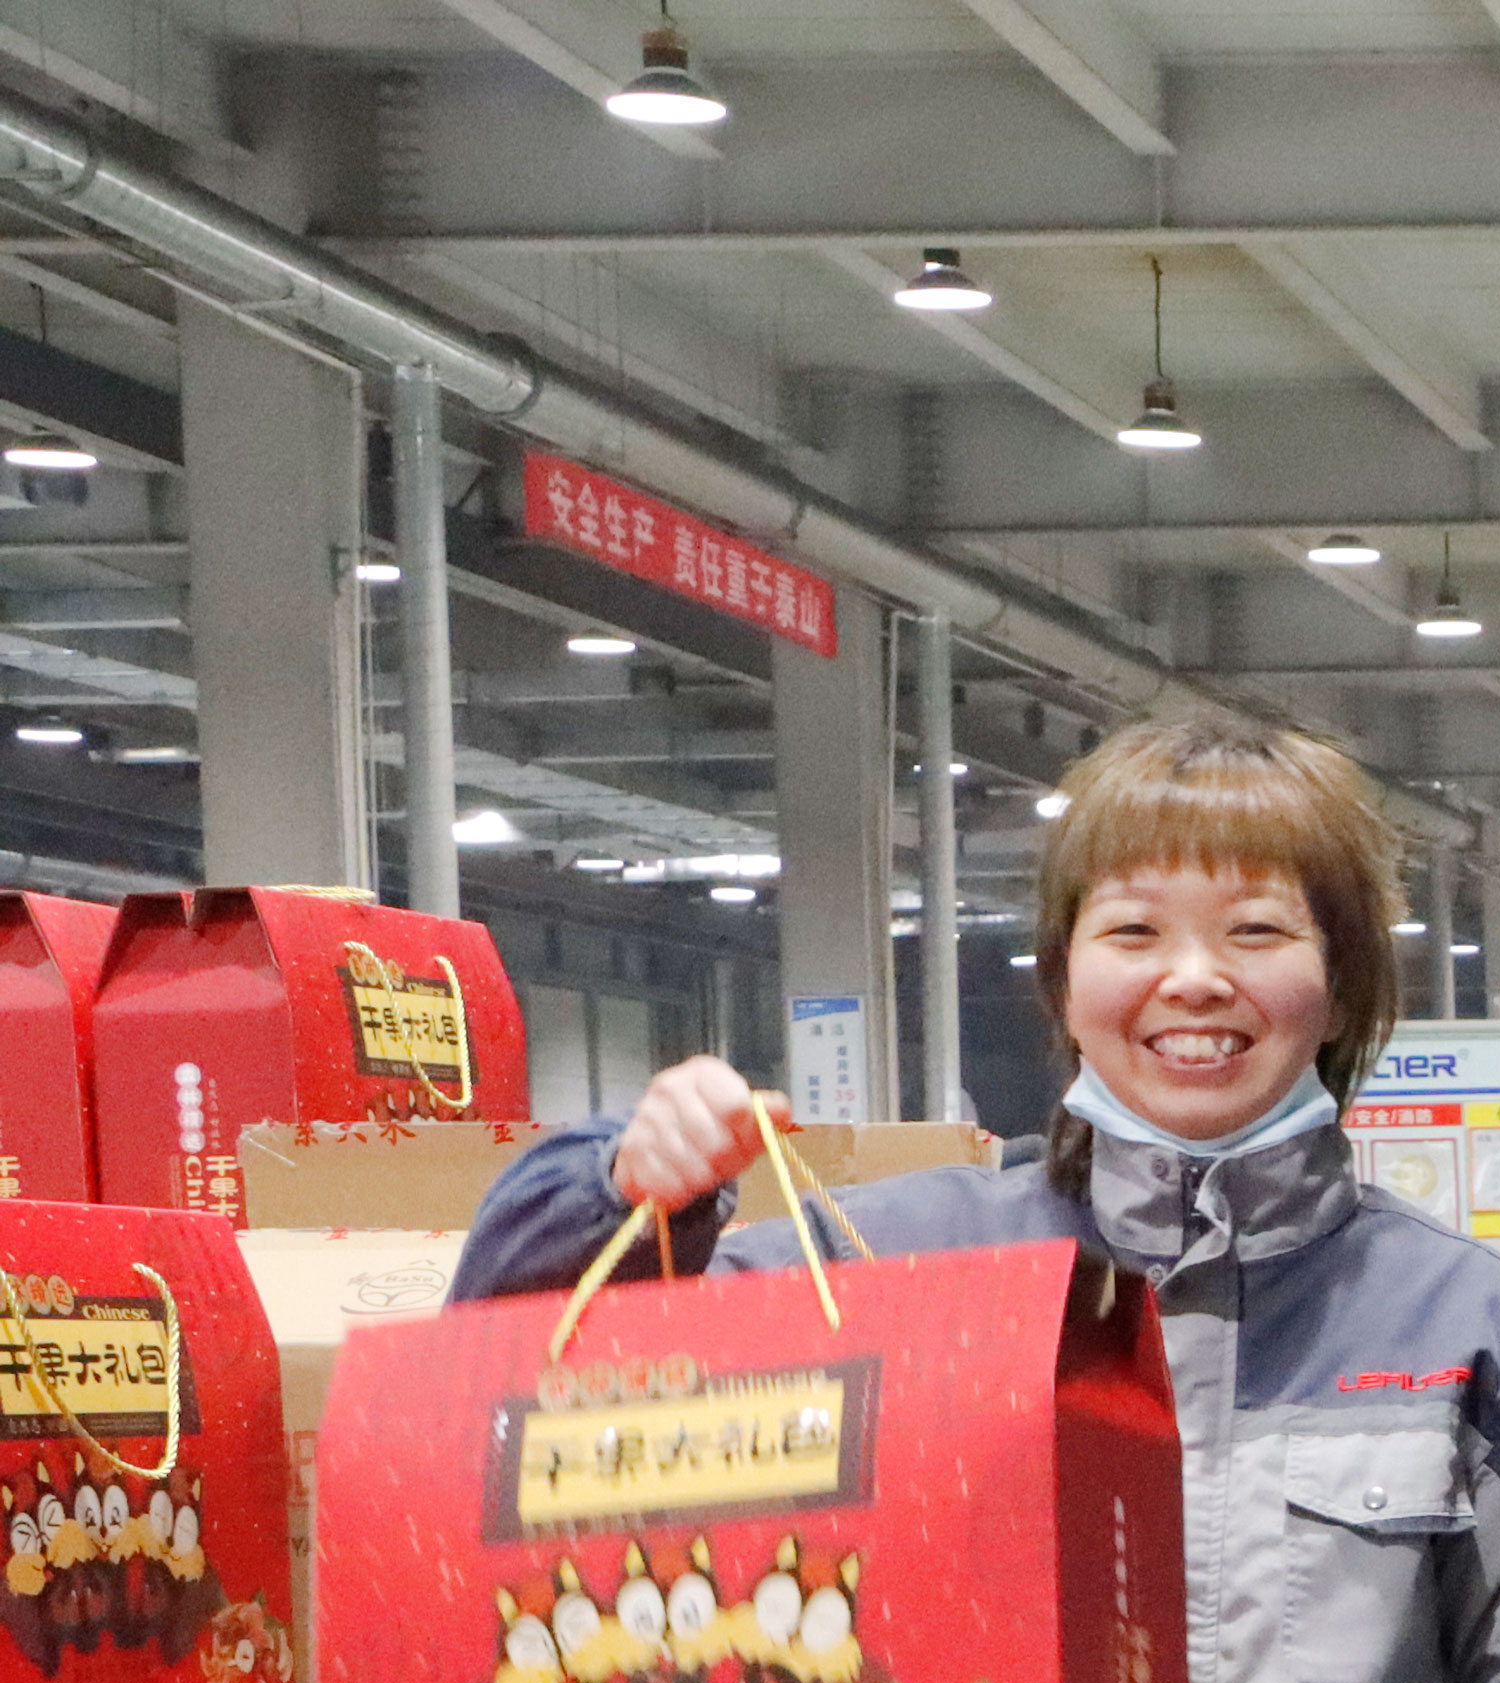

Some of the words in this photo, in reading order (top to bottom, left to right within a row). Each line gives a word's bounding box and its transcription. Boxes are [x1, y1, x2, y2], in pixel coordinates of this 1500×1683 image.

[549, 470, 656, 561] 安全生产
[673, 524, 821, 640] 责任重于泰山
[81, 1304, 151, 1321] Chinese
